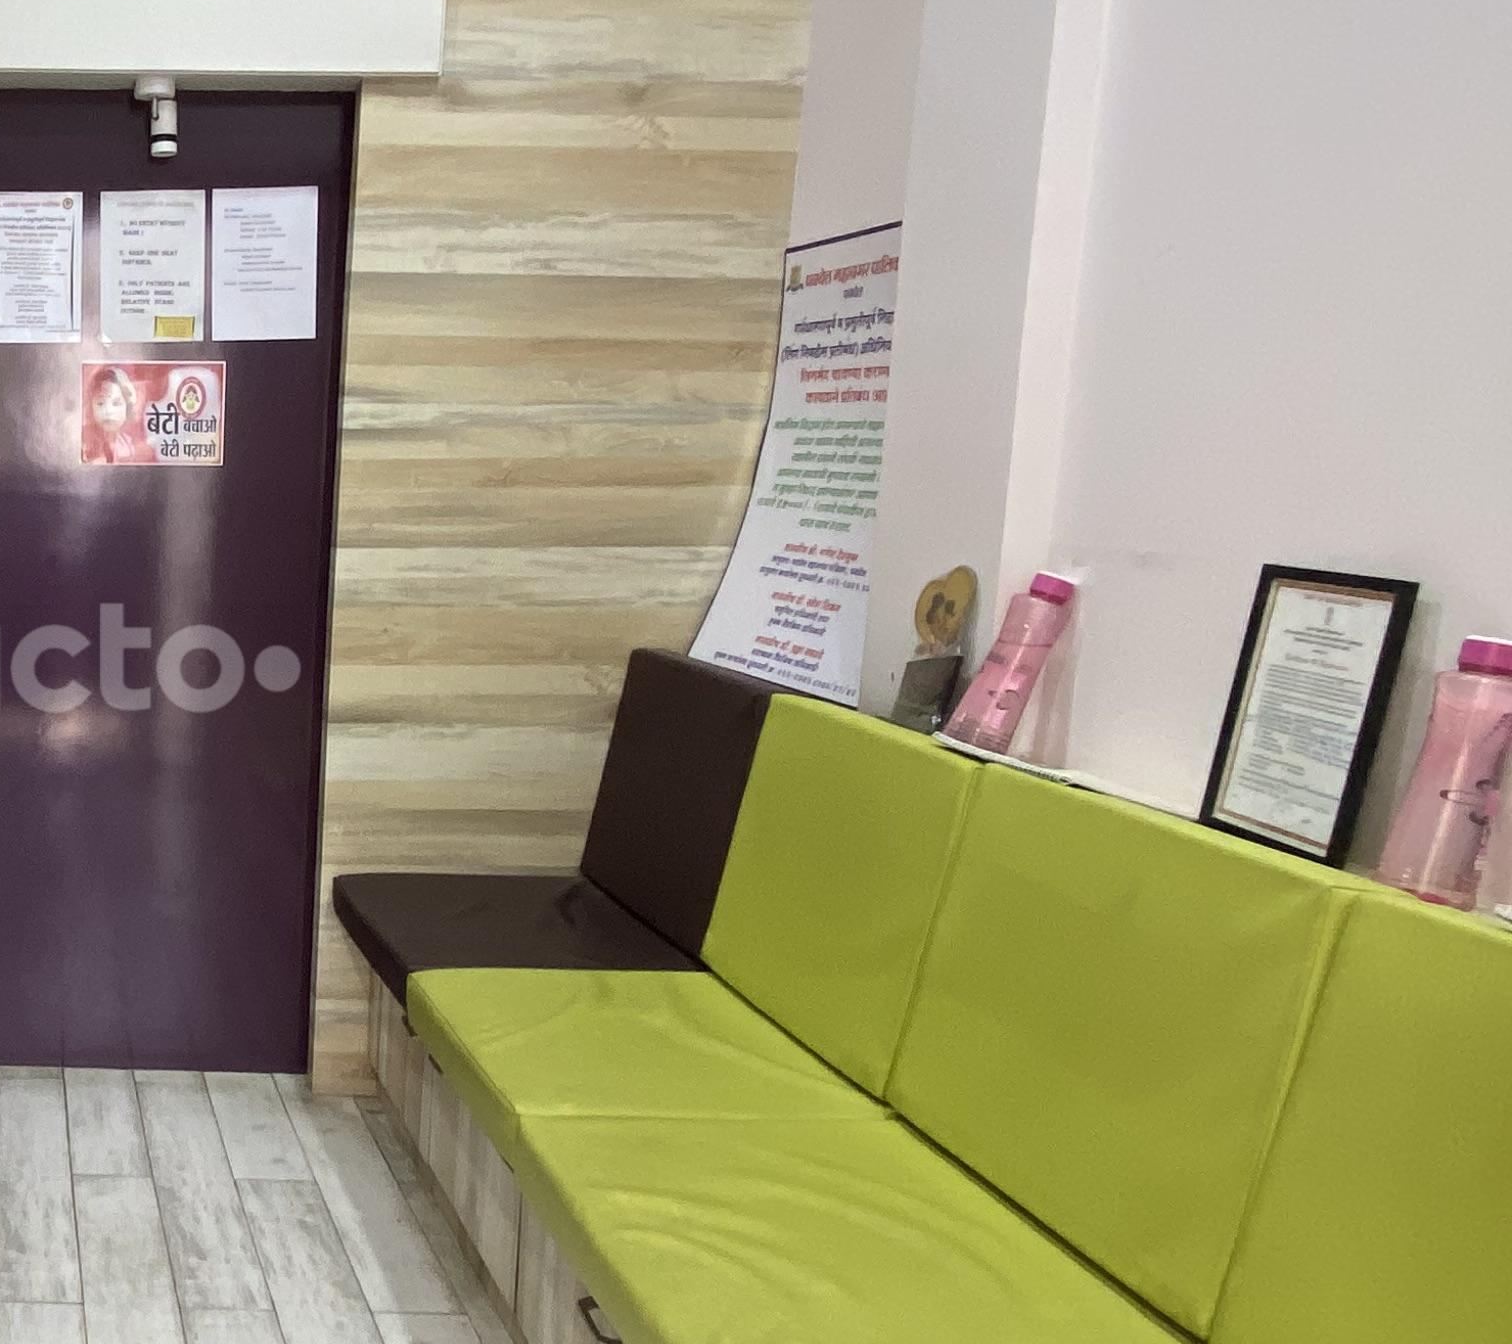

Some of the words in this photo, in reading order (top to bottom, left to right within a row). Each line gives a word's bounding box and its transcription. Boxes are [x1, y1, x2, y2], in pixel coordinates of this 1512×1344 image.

[146, 403, 180, 435] बेटी
[183, 416, 217, 433] बचाओ
[160, 439, 179, 457] बेटी
[183, 440, 216, 460] पढ़ाओ
